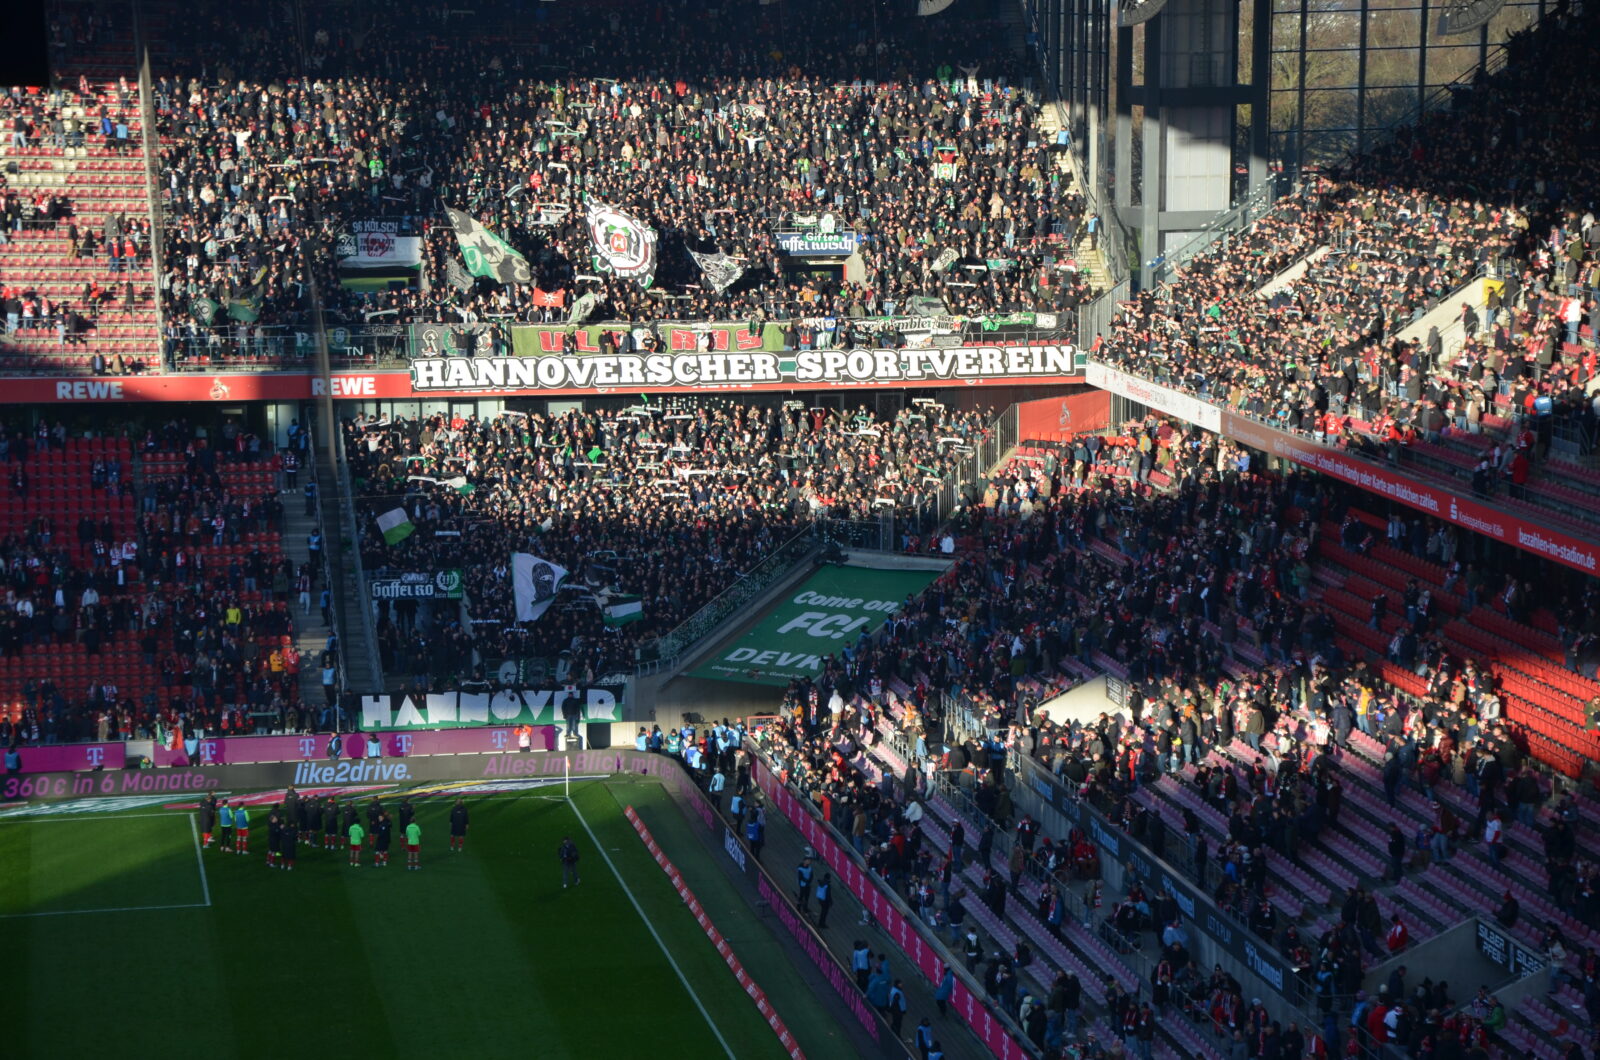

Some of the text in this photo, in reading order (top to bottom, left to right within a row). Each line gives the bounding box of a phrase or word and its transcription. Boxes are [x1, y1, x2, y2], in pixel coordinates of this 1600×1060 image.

[413, 345, 1074, 389] HANNOVERSCHER SPORTVEREIN
[56, 381, 123, 399] REWE
[311, 377, 376, 396] REWE
[793, 591, 863, 609] Come
[776, 611, 871, 640] FC!
[724, 647, 828, 671] DEVK
[294, 759, 412, 785] like2drive.
[483, 757, 537, 776] Alles
[574, 751, 625, 773] Blick
[4, 776, 50, 798] 360
[72, 774, 95, 795] in
[100, 773, 115, 793] 6
